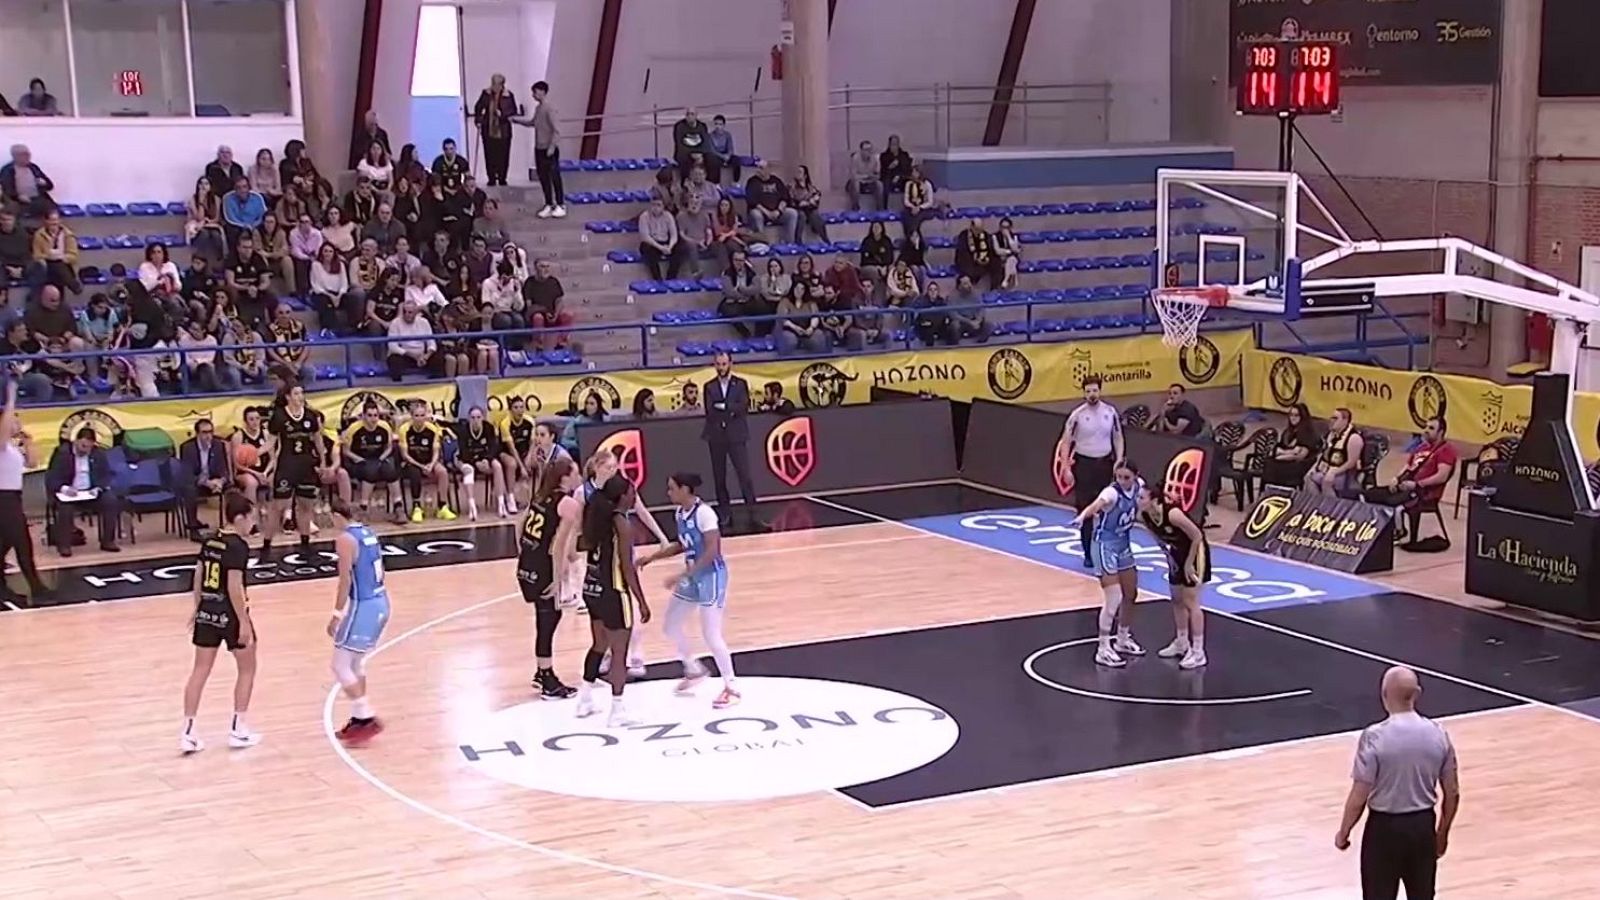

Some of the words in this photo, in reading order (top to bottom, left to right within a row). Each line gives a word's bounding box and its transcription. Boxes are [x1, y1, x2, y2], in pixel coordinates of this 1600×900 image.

[1250, 71, 1276, 107] 14
[1297, 71, 1331, 107] 14
[873, 363, 966, 388] HOZONO
[1320, 375, 1393, 401] HOZONO
[1515, 465, 1560, 481] HOZONO
[1477, 532, 1497, 559] La
[1503, 538, 1577, 576] Hacienda
[460, 706, 946, 762] HOZONO
